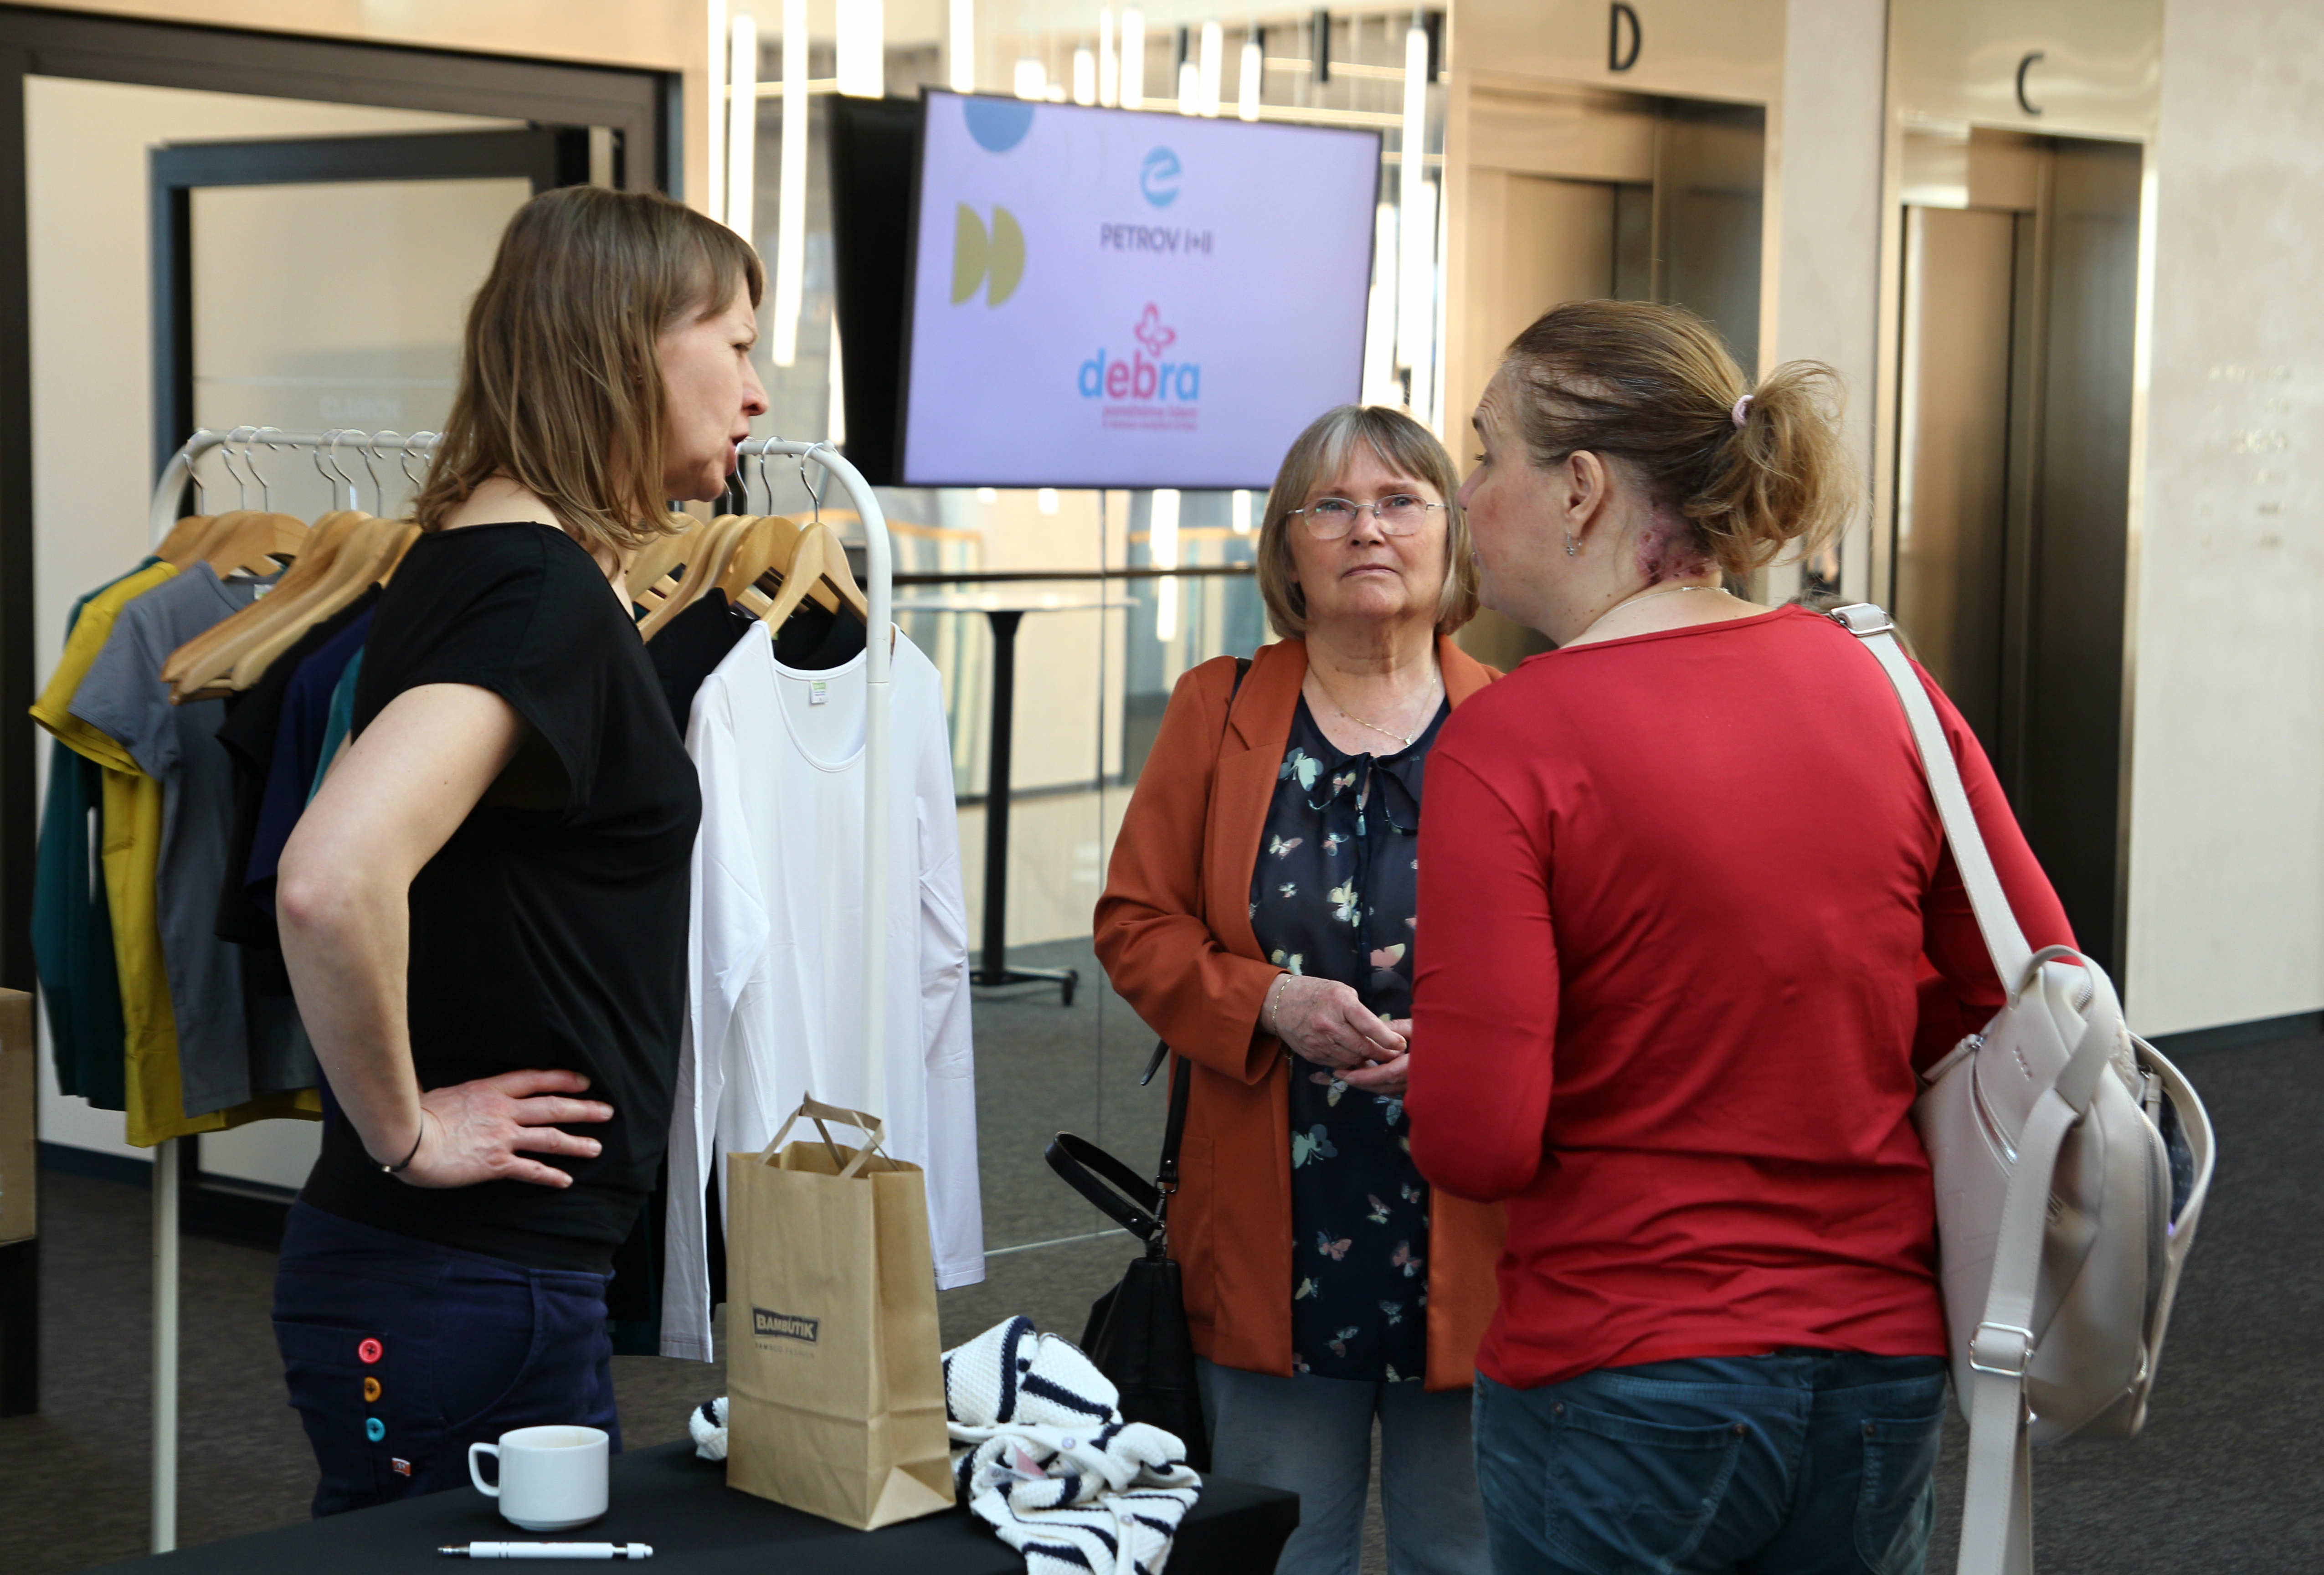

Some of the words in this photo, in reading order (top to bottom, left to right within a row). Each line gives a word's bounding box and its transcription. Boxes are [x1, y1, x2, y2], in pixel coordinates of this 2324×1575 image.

[1609, 4, 1641, 71] D
[2015, 52, 2043, 115] C
[1101, 222, 1181, 252] PETROV
[1079, 347, 1199, 399] debra
